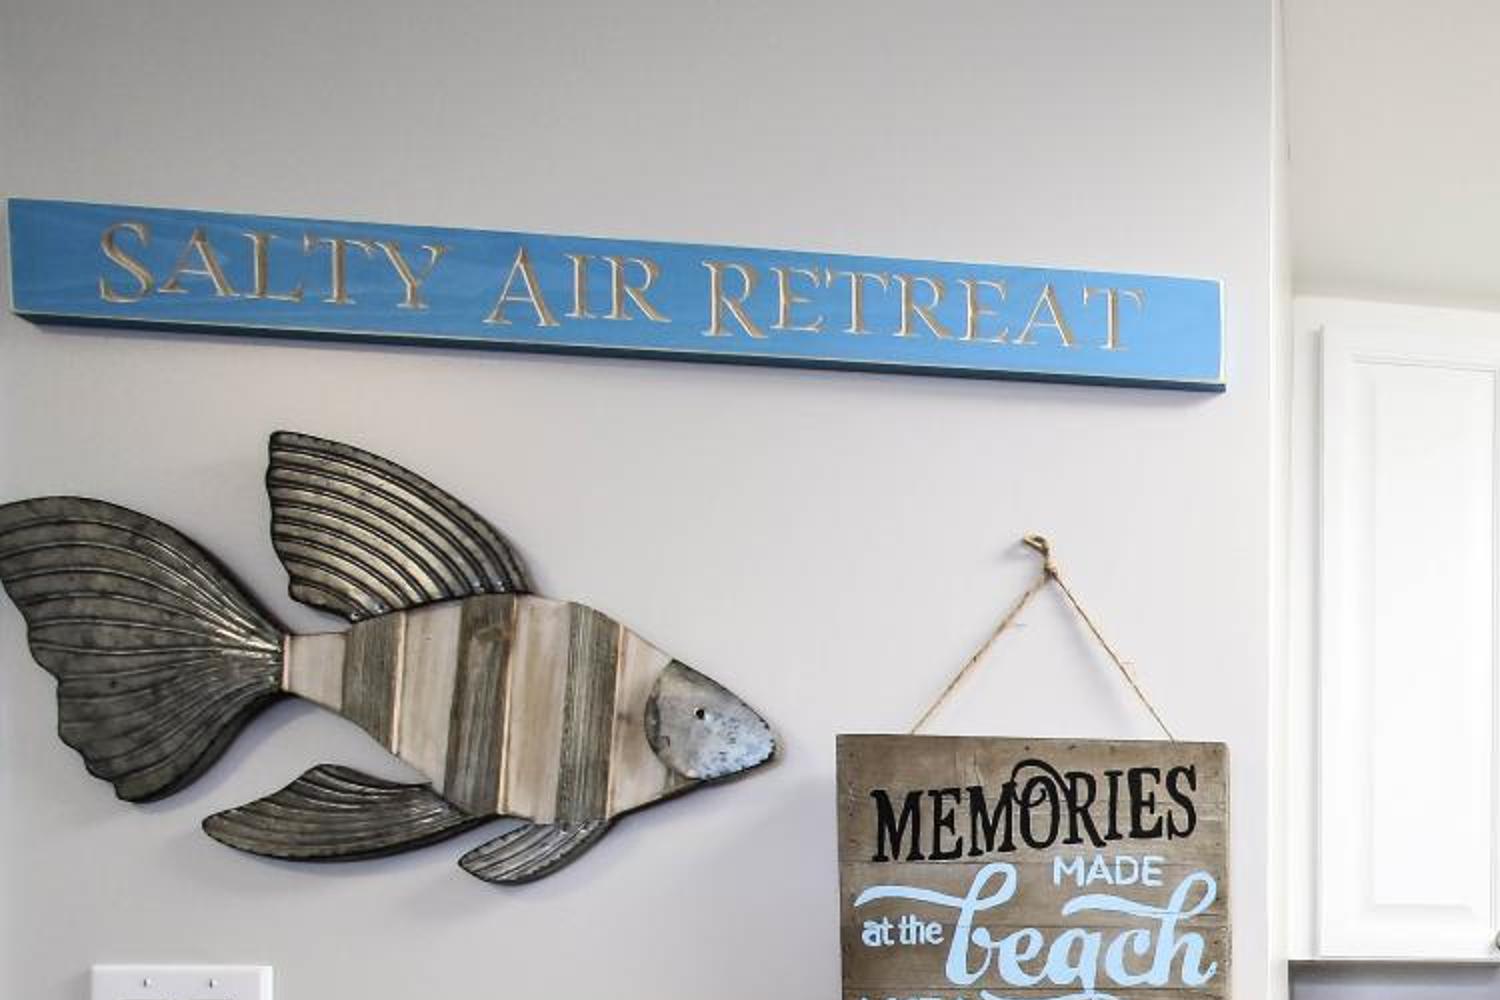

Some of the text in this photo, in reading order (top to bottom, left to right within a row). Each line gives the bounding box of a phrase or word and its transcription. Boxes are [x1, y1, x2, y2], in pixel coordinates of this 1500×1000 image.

[99, 222, 1145, 351] SALTY AIR RETREAT
[869, 758, 1198, 862] MEMORIES
[1052, 855, 1166, 887] MADE
[861, 918, 897, 946] at
[897, 915, 944, 945] the
